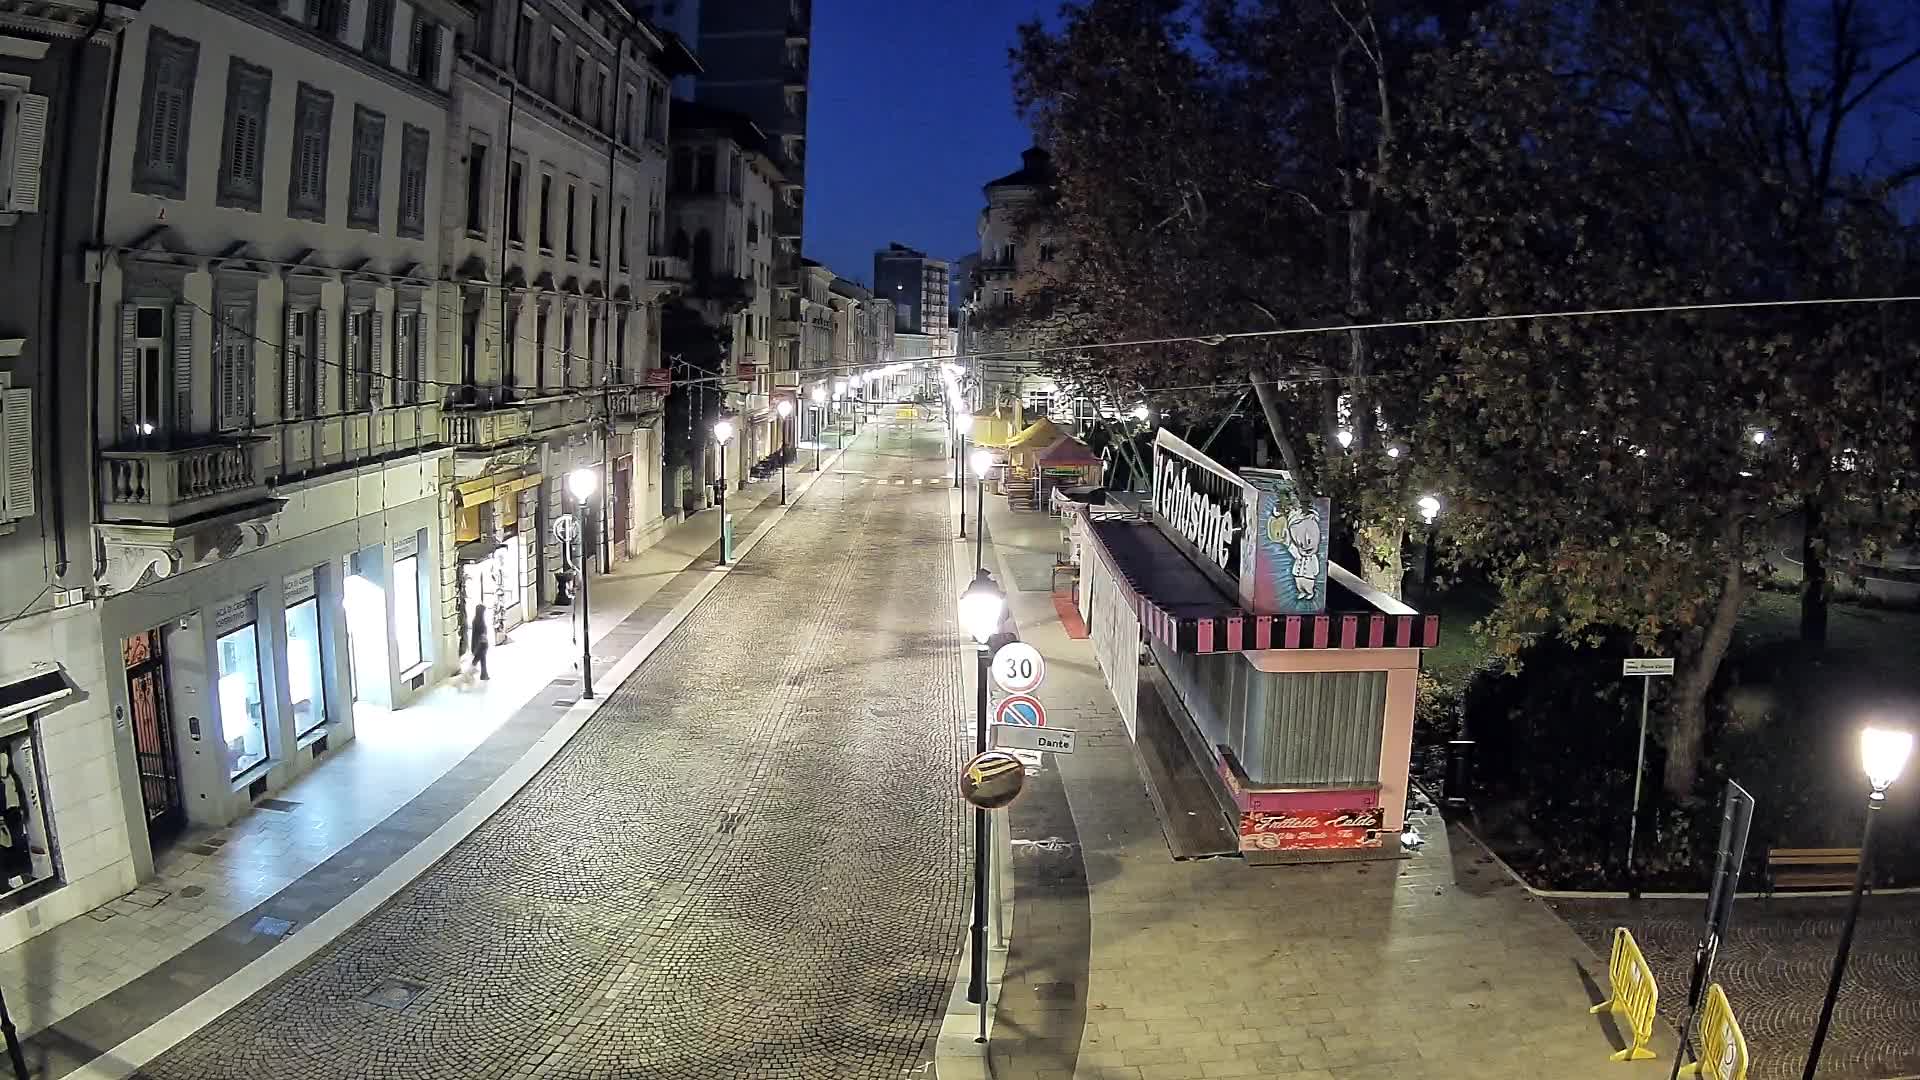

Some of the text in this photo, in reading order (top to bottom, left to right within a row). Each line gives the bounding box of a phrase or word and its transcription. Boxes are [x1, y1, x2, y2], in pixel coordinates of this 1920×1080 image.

[1163, 458, 1233, 569] Golosone
[1006, 658, 1032, 679] 30
[1038, 737, 1070, 749] Dante
